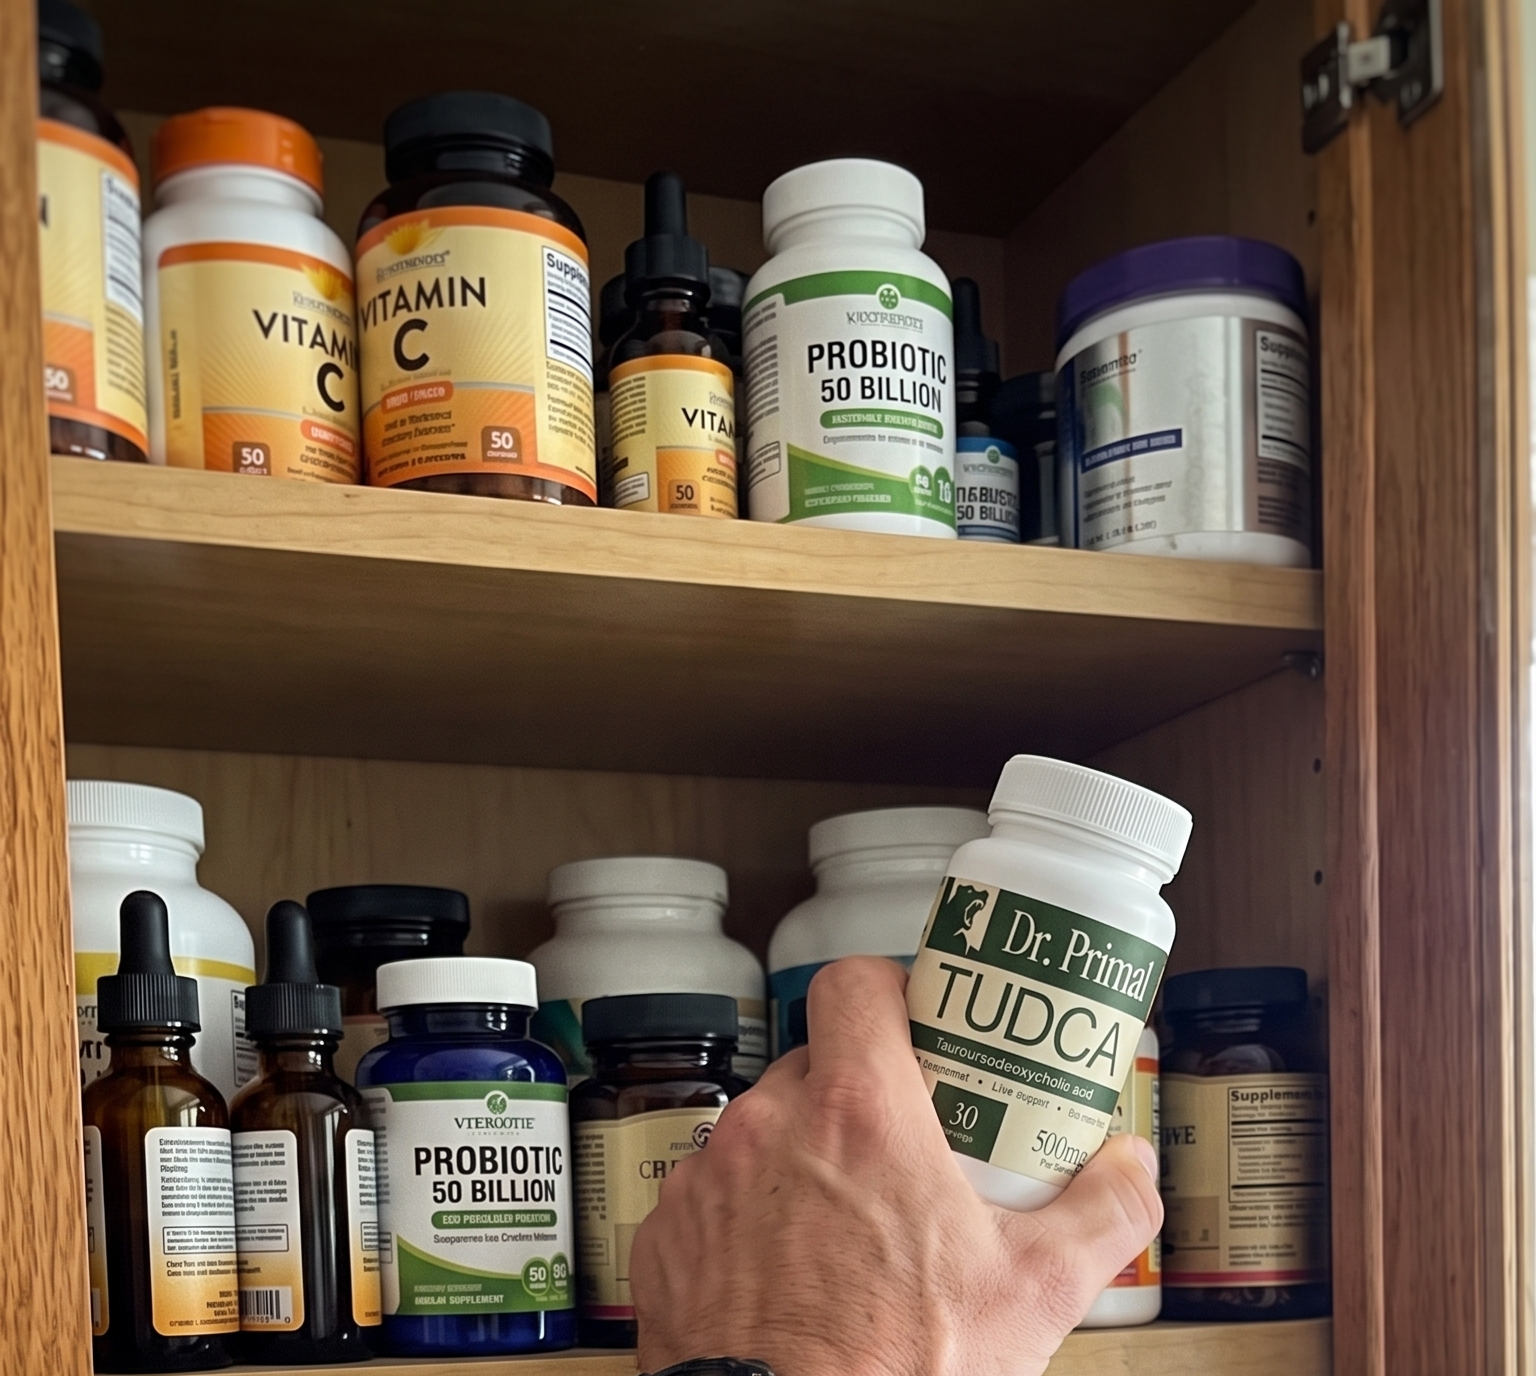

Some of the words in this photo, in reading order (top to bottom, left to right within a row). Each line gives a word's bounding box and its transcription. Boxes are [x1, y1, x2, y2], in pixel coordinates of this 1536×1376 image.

[360, 275, 487, 334] VITAMIN
[393, 318, 430, 372] C
[807, 339, 947, 386] PROBIOTIC
[316, 362, 346, 413] C
[821, 377, 851, 404] 50
[860, 376, 942, 414] BILLION
[490, 431, 514, 450] 50
[241, 447, 265, 466] 50
[675, 484, 695, 501] 50
[1001, 908, 1053, 966] Dr.
[1058, 927, 1155, 1003] Primal
[936, 961, 1121, 1078] TUDCA
[991, 1080, 1014, 1097] Live
[949, 1102, 979, 1130] 30
[414, 1145, 563, 1176] PROBIOTIC
[432, 1180, 463, 1204] 50
[471, 1179, 556, 1203] BILLION
[529, 1266, 547, 1282] 50
